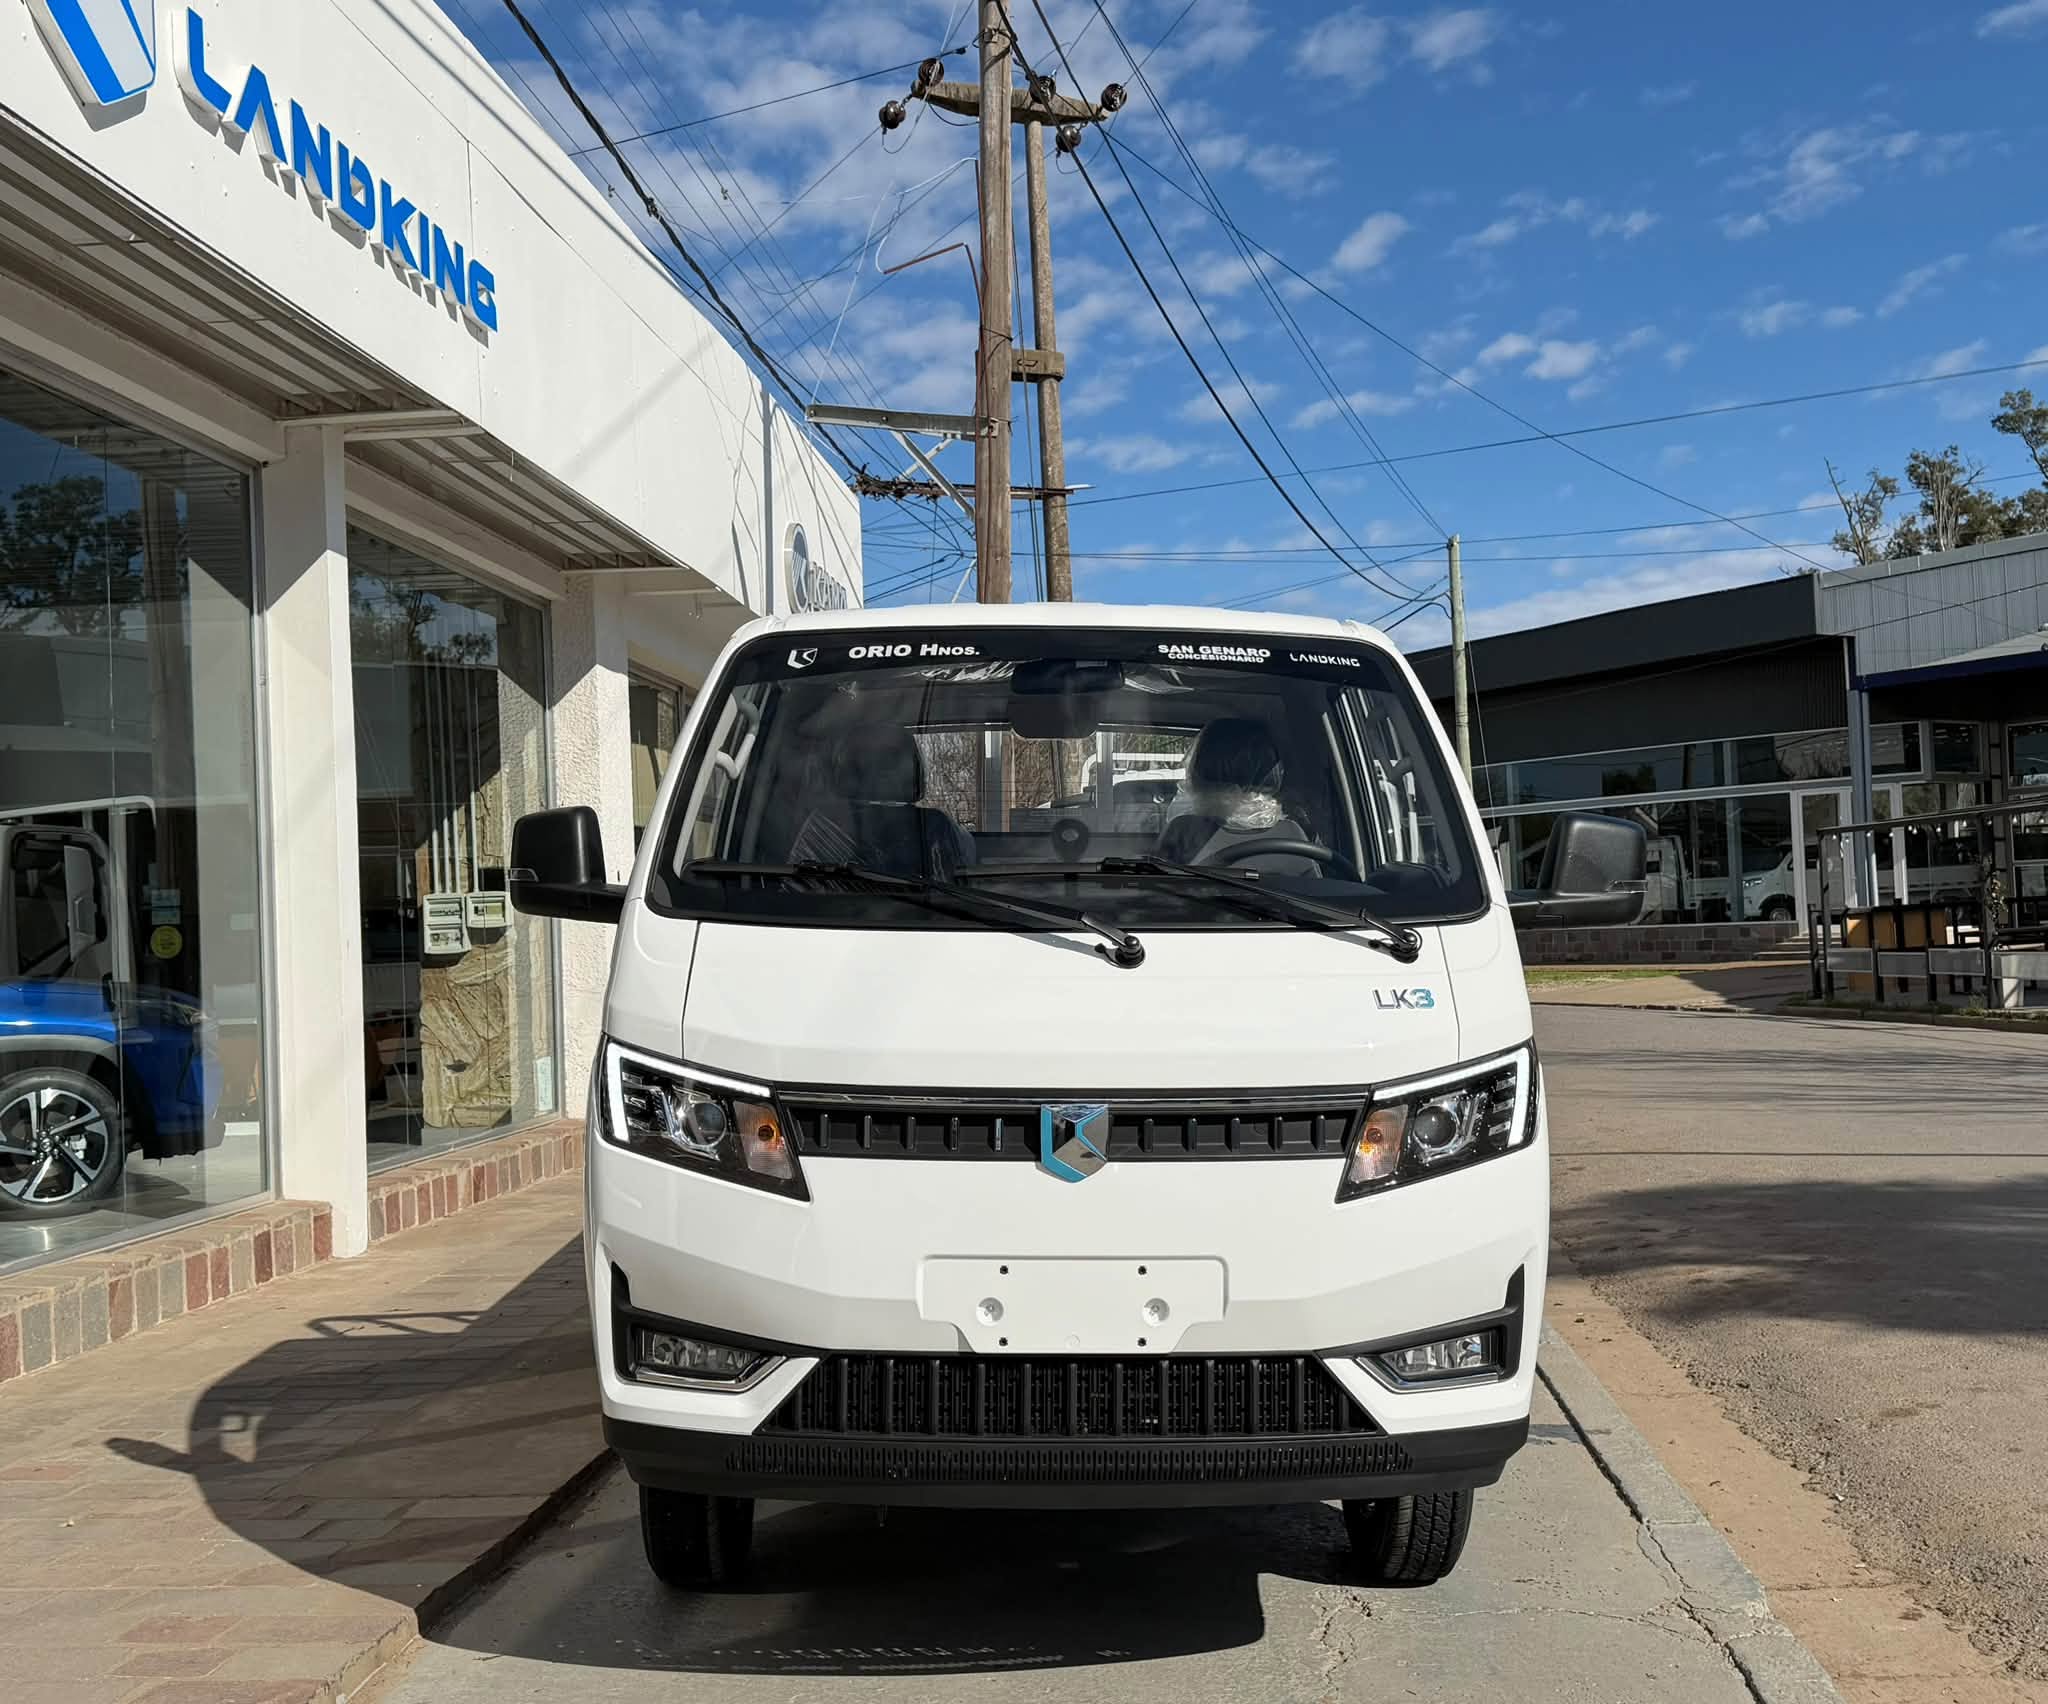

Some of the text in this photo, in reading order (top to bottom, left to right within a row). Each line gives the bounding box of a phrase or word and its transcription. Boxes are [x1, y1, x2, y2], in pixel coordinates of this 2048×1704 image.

[187, 7, 498, 333] LANDKING
[849, 644, 912, 659] ORIO
[1158, 644, 1271, 658] SAN GENARO
[1168, 653, 1265, 663] CONCESIONARIO
[1290, 653, 1361, 667] LANDKING
[1372, 988, 1435, 1009] LK3
